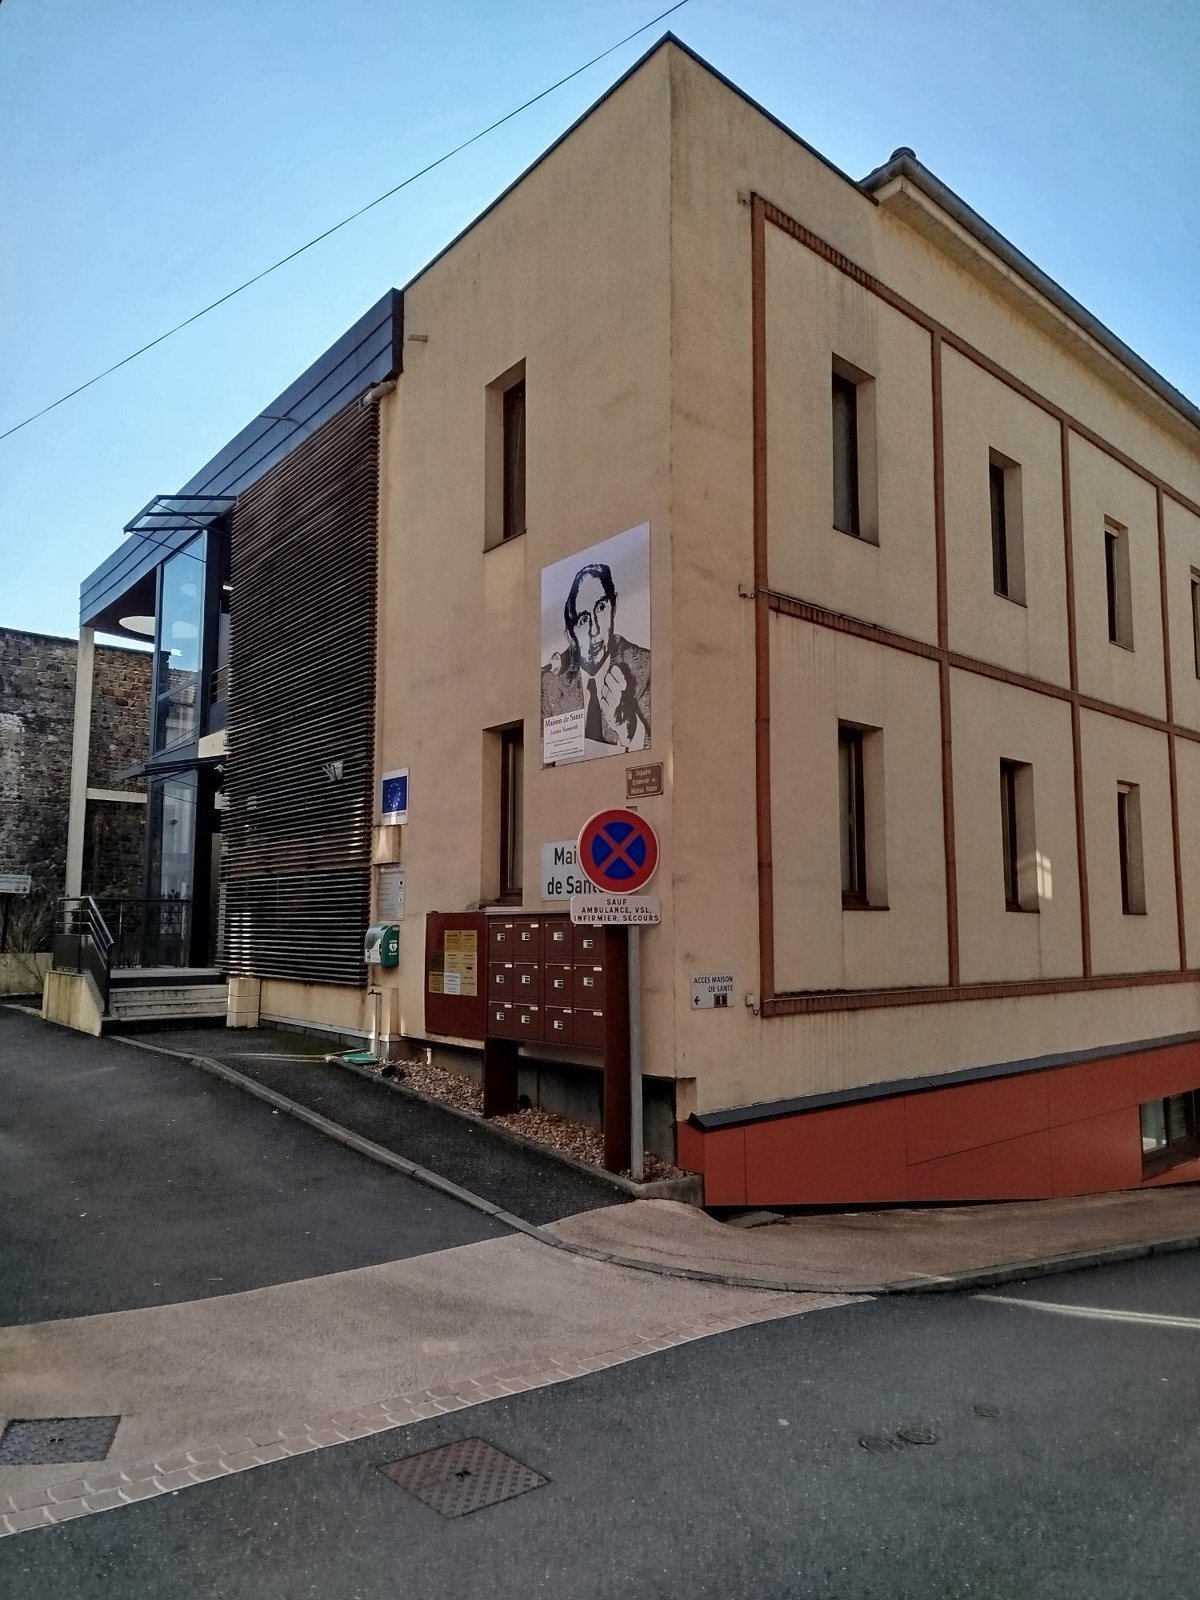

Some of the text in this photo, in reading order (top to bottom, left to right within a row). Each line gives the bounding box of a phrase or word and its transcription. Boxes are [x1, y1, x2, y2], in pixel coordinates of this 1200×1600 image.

[545, 718, 562, 726] Maison
[563, 715, 569, 723] de
[554, 845, 577, 865] Mai
[547, 876, 562, 895] de
[622, 914, 659, 922] SECOURS
